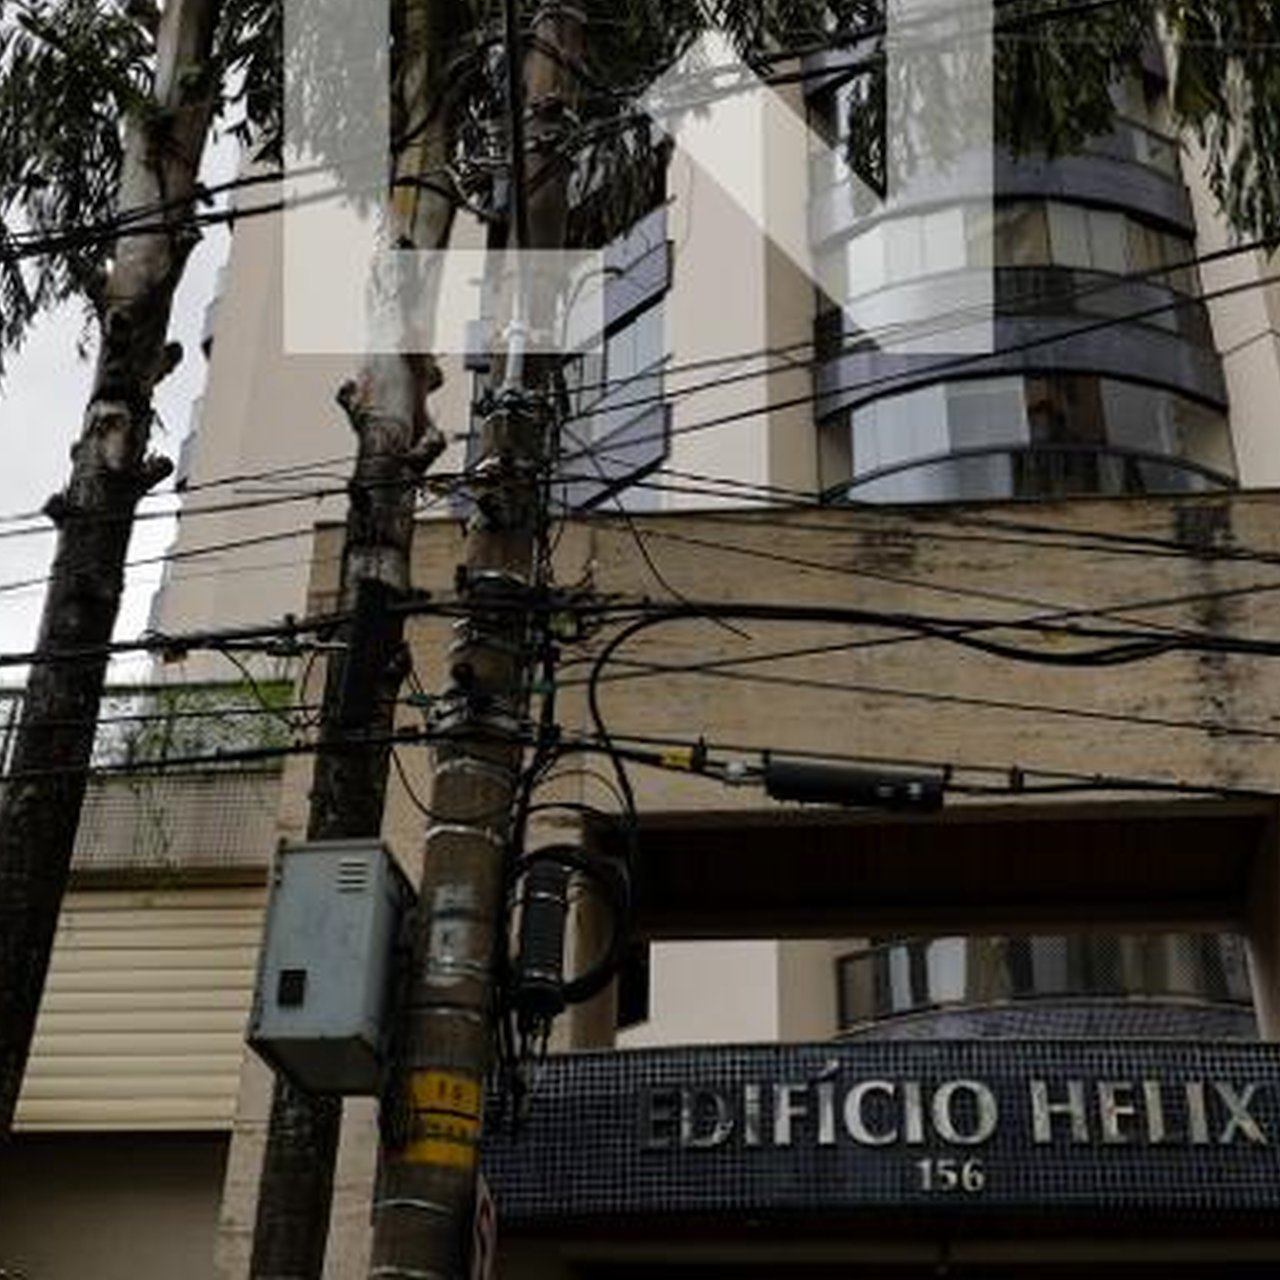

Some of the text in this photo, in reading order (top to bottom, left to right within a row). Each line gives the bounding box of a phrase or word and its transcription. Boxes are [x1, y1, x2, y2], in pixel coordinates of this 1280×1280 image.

[640, 1059, 1270, 1147] EDIFÍCIO HELIX
[919, 1158, 986, 1192] 156
